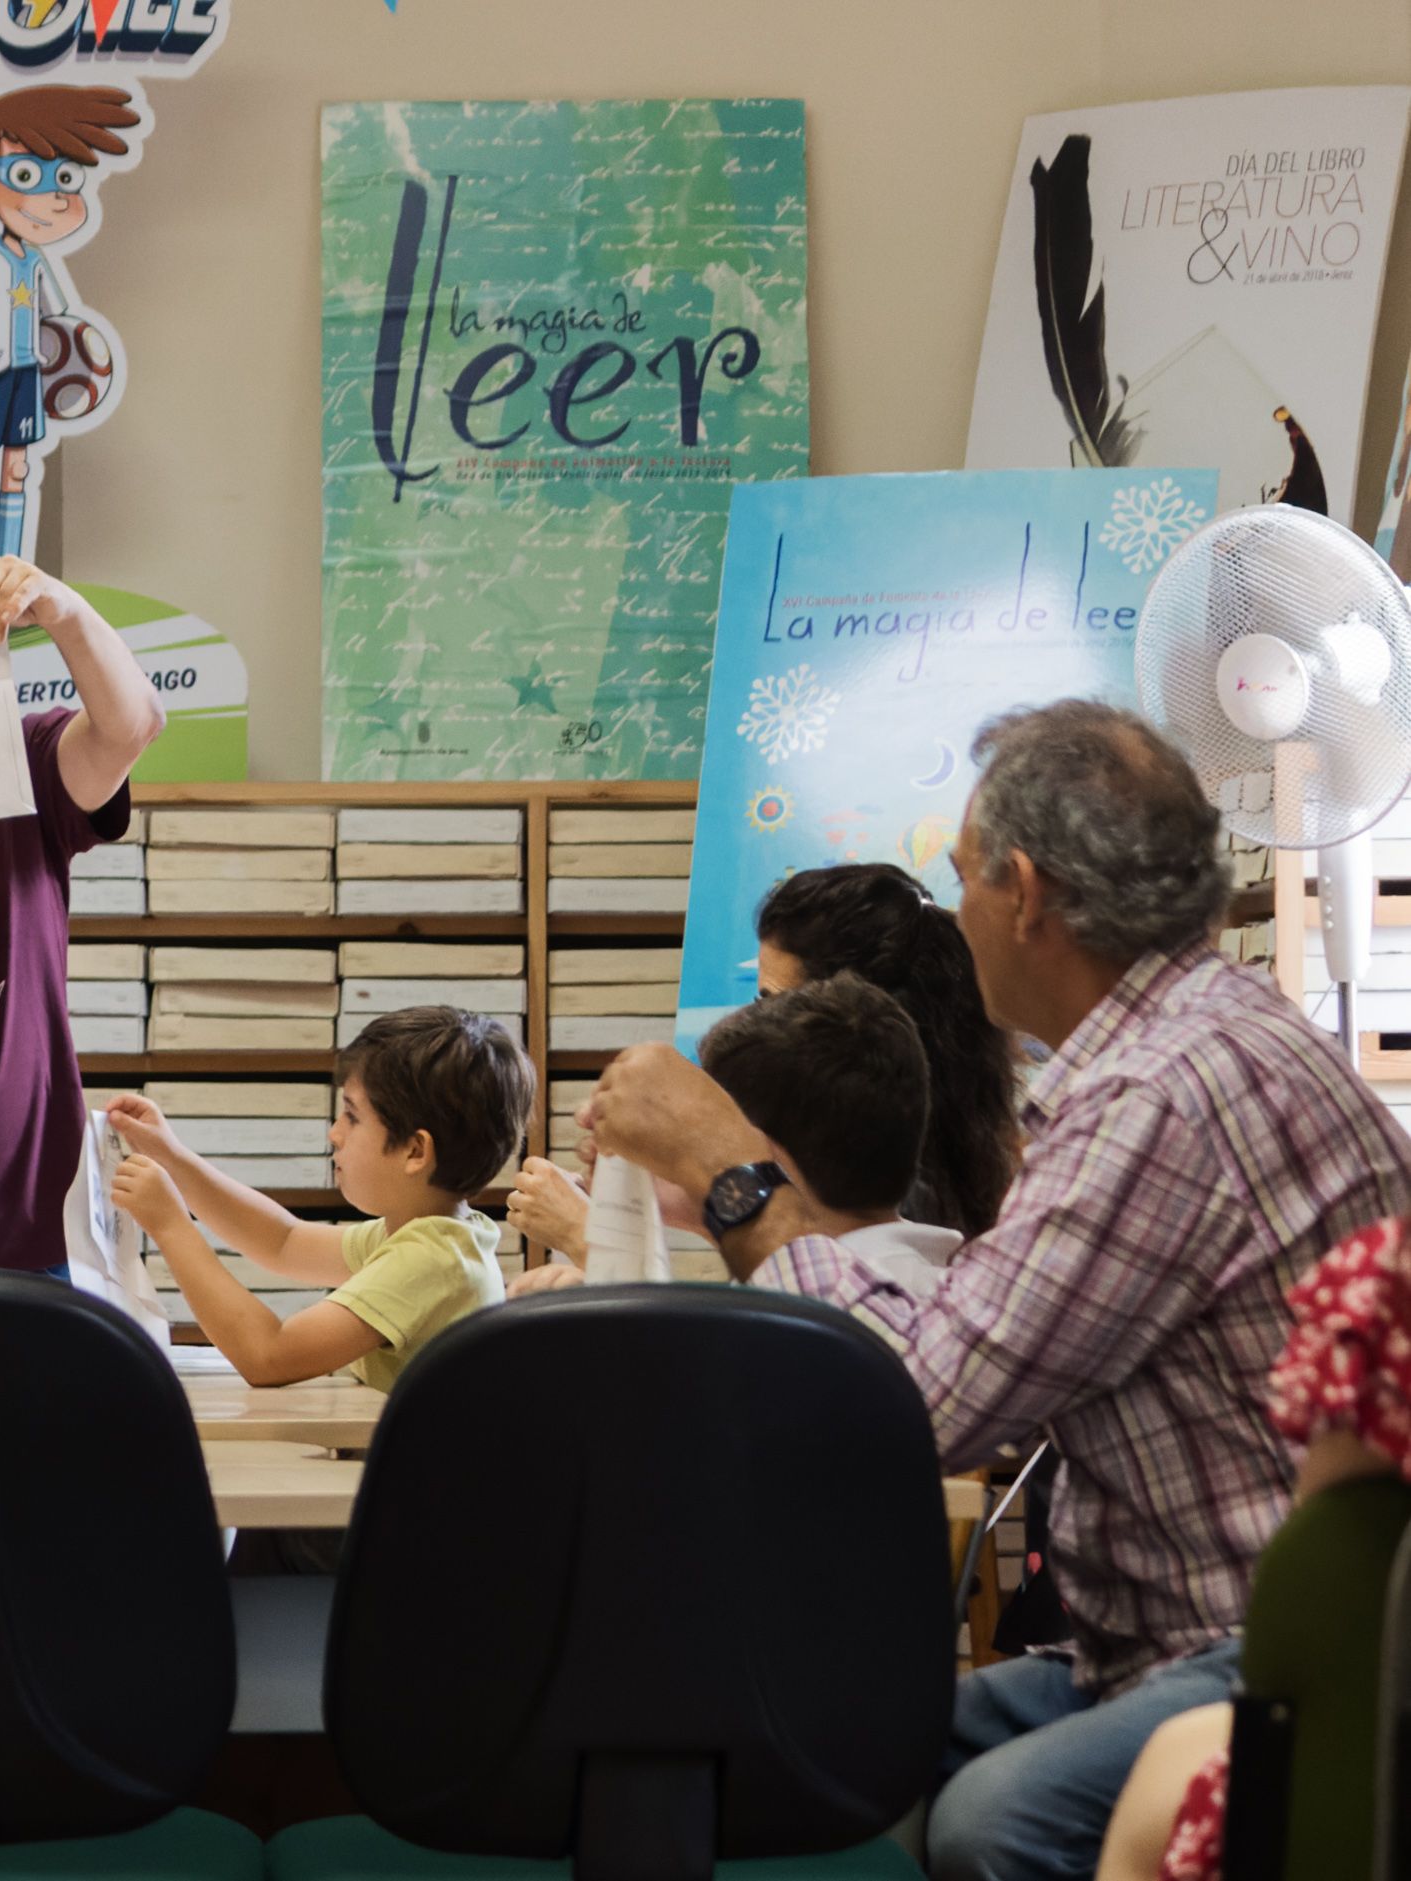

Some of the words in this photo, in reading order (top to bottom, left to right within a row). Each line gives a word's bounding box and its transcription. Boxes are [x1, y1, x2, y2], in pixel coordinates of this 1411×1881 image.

[1225, 149, 1257, 177] DÍA
[1263, 151, 1299, 175] DEL
[1306, 147, 1366, 172] LIBRO
[1121, 173, 1364, 231] LITERATURA
[1187, 208, 1240, 285] &
[1241, 221, 1361, 269] VINO
[450, 286, 486, 337] la
[493, 303, 605, 354] magia
[612, 292, 647, 334] de
[19, 416, 33, 439] 11
[763, 532, 814, 643] La
[834, 604, 975, 682] magia
[997, 521, 1048, 632] de
[1072, 520, 1138, 631] lee
[15, 679, 77, 703] ERTO
[145, 668, 197, 691] AGO
